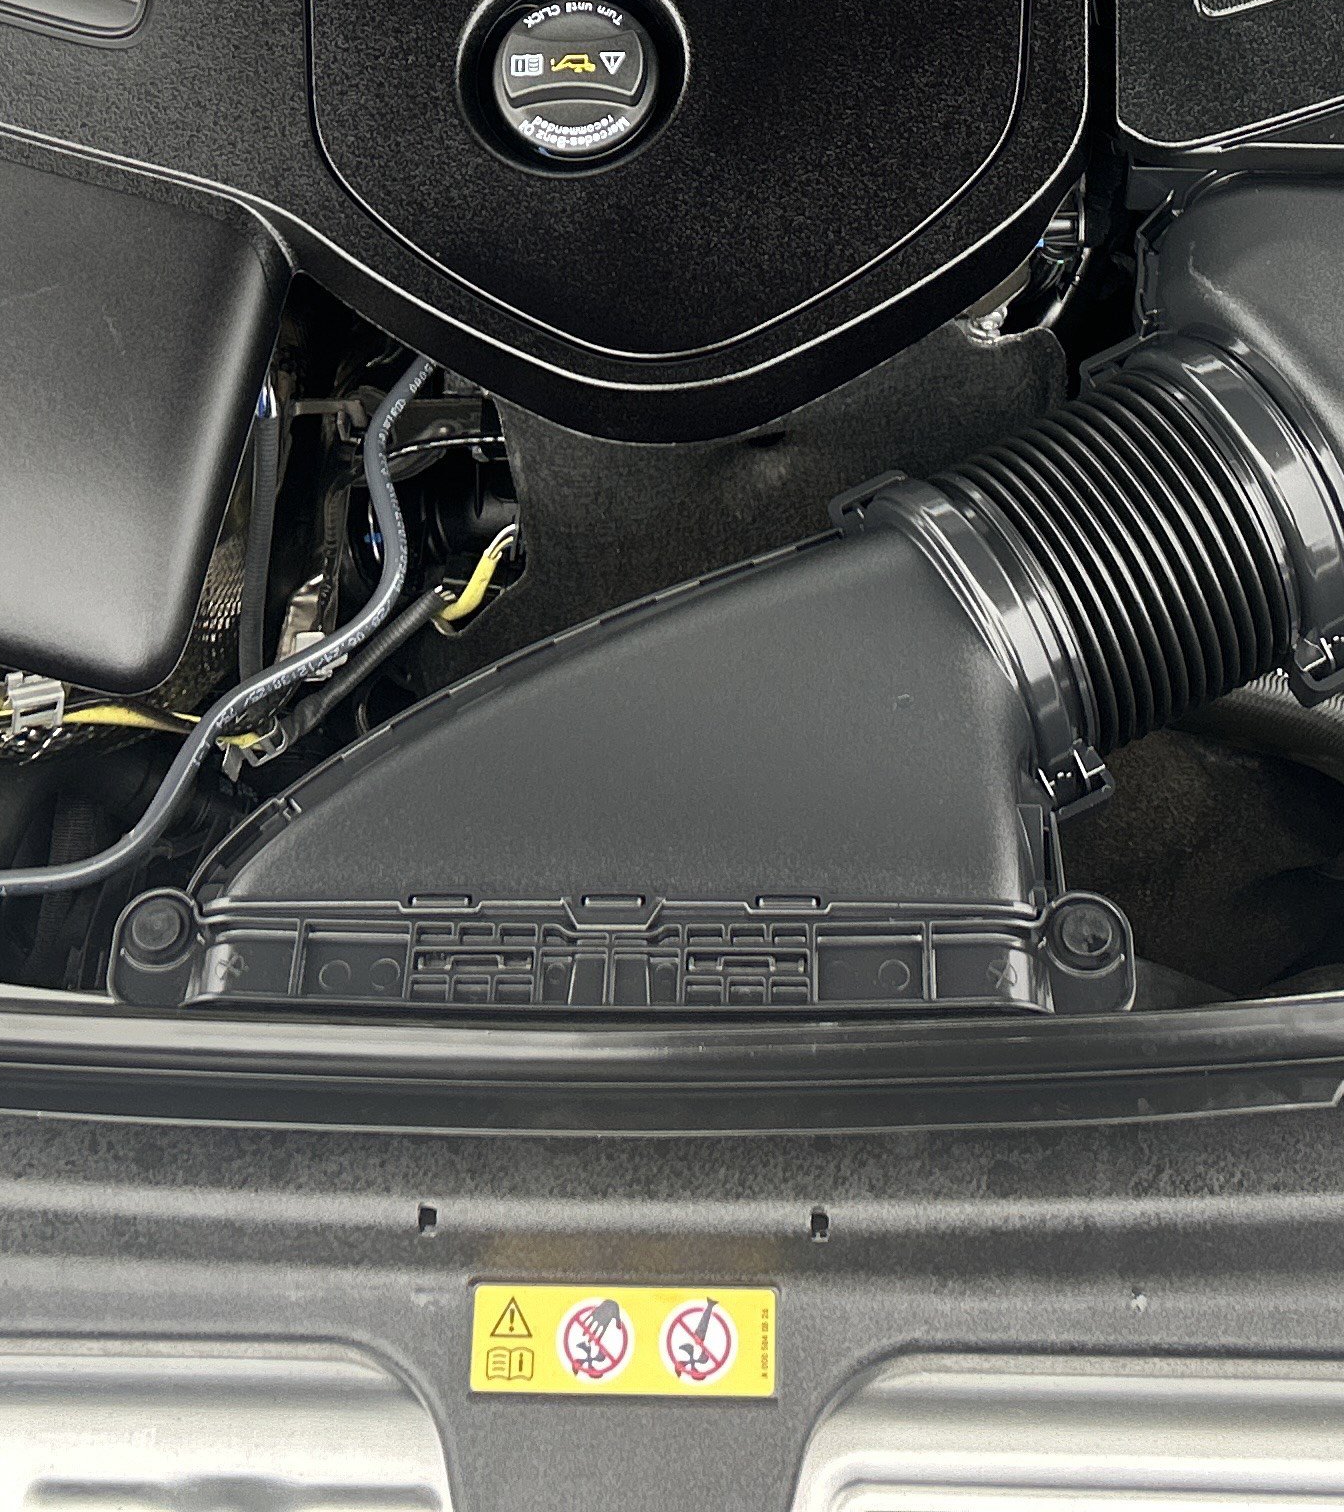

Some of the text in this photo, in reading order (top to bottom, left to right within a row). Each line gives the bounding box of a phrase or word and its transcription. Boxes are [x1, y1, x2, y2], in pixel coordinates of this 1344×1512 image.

[523, 2, 624, 28] Turn until CLICK
